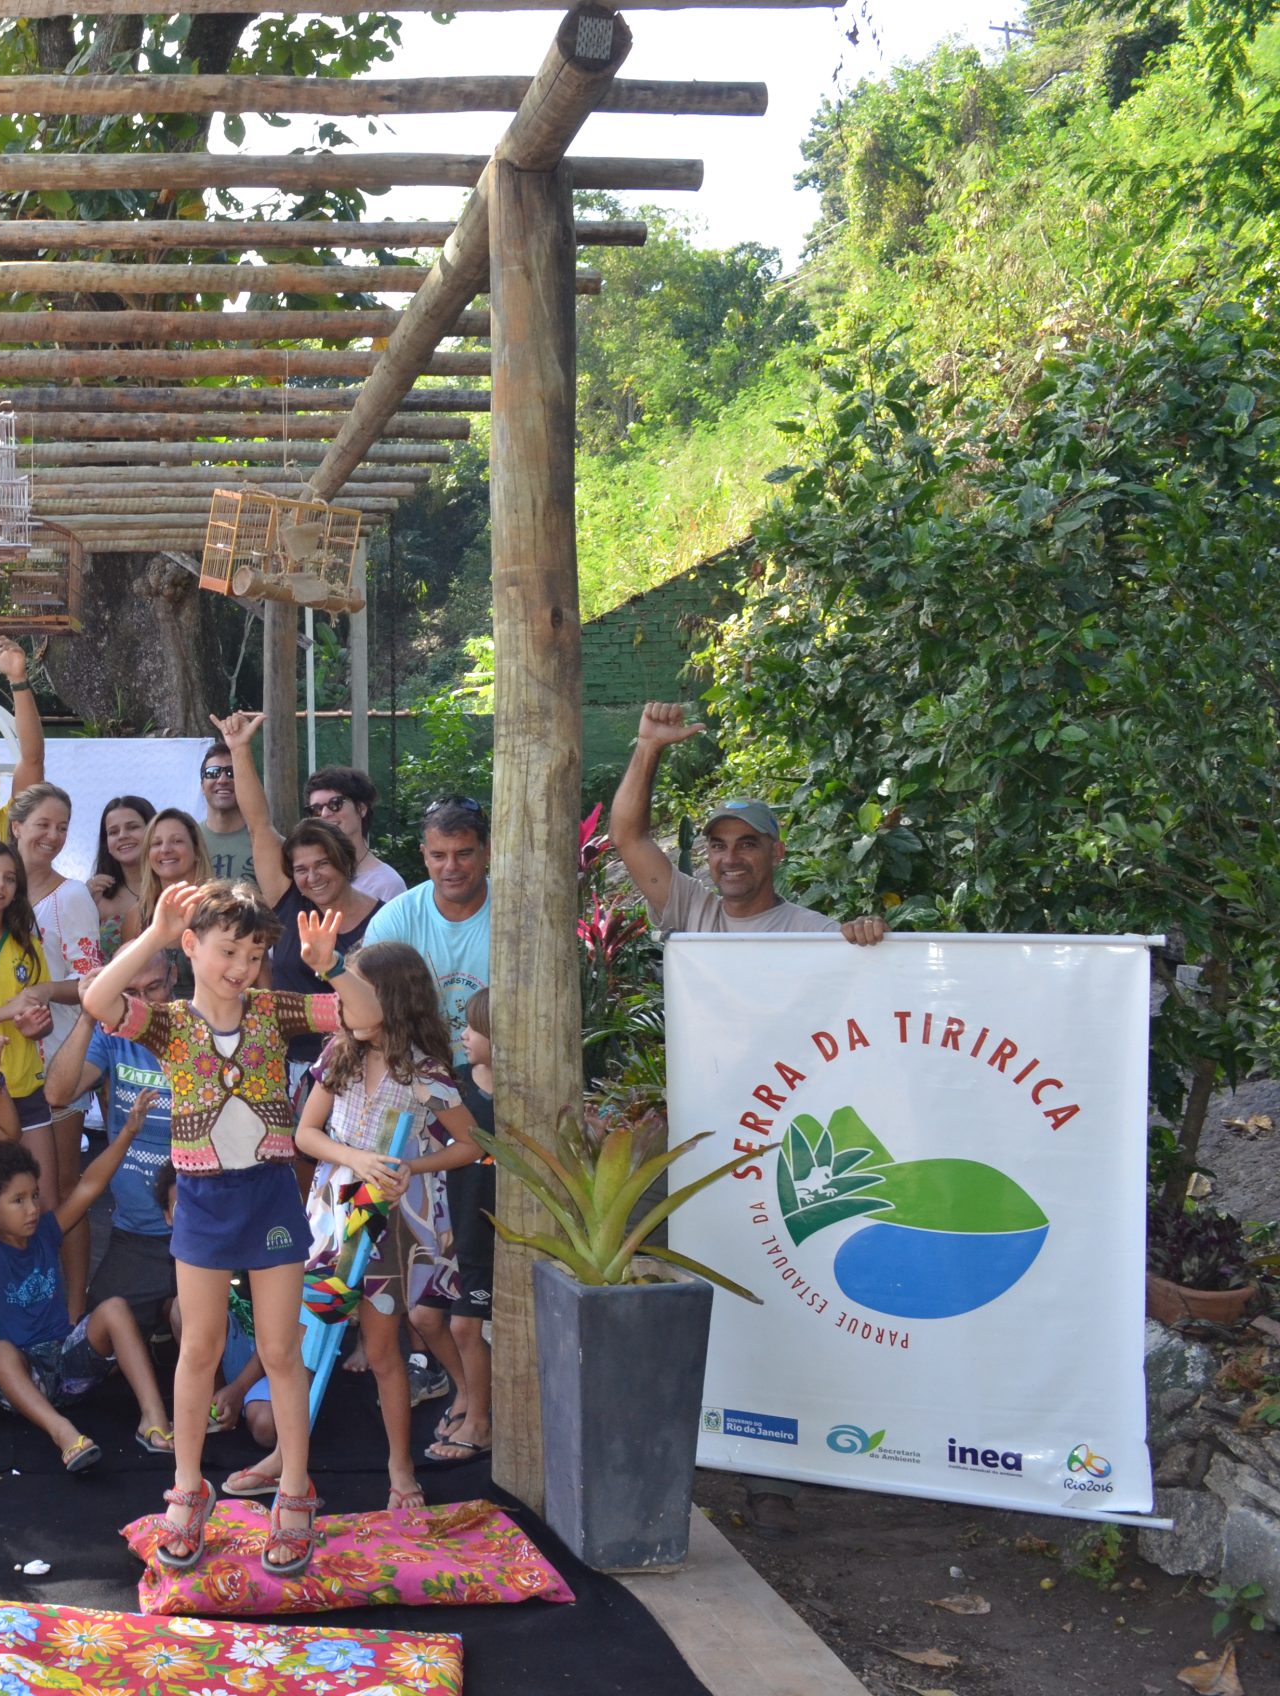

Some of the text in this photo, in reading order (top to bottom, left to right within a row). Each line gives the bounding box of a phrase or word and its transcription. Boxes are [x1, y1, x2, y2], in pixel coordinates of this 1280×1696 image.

[443, 977, 479, 991] MESTRE
[731, 1011, 1081, 1180] SERRA DA TIRIRICA
[749, 1201, 909, 1349] PARQUE ESTADUAL DA
[726, 1417, 752, 1426] GOVERNO
[726, 1422, 794, 1441] Rio de Janeiro
[869, 1452, 921, 1464] do Ambiente
[878, 1446, 921, 1458] Secretaria
[948, 1437, 1023, 1472] inea
[1063, 1478, 1114, 1493] Rio2016
